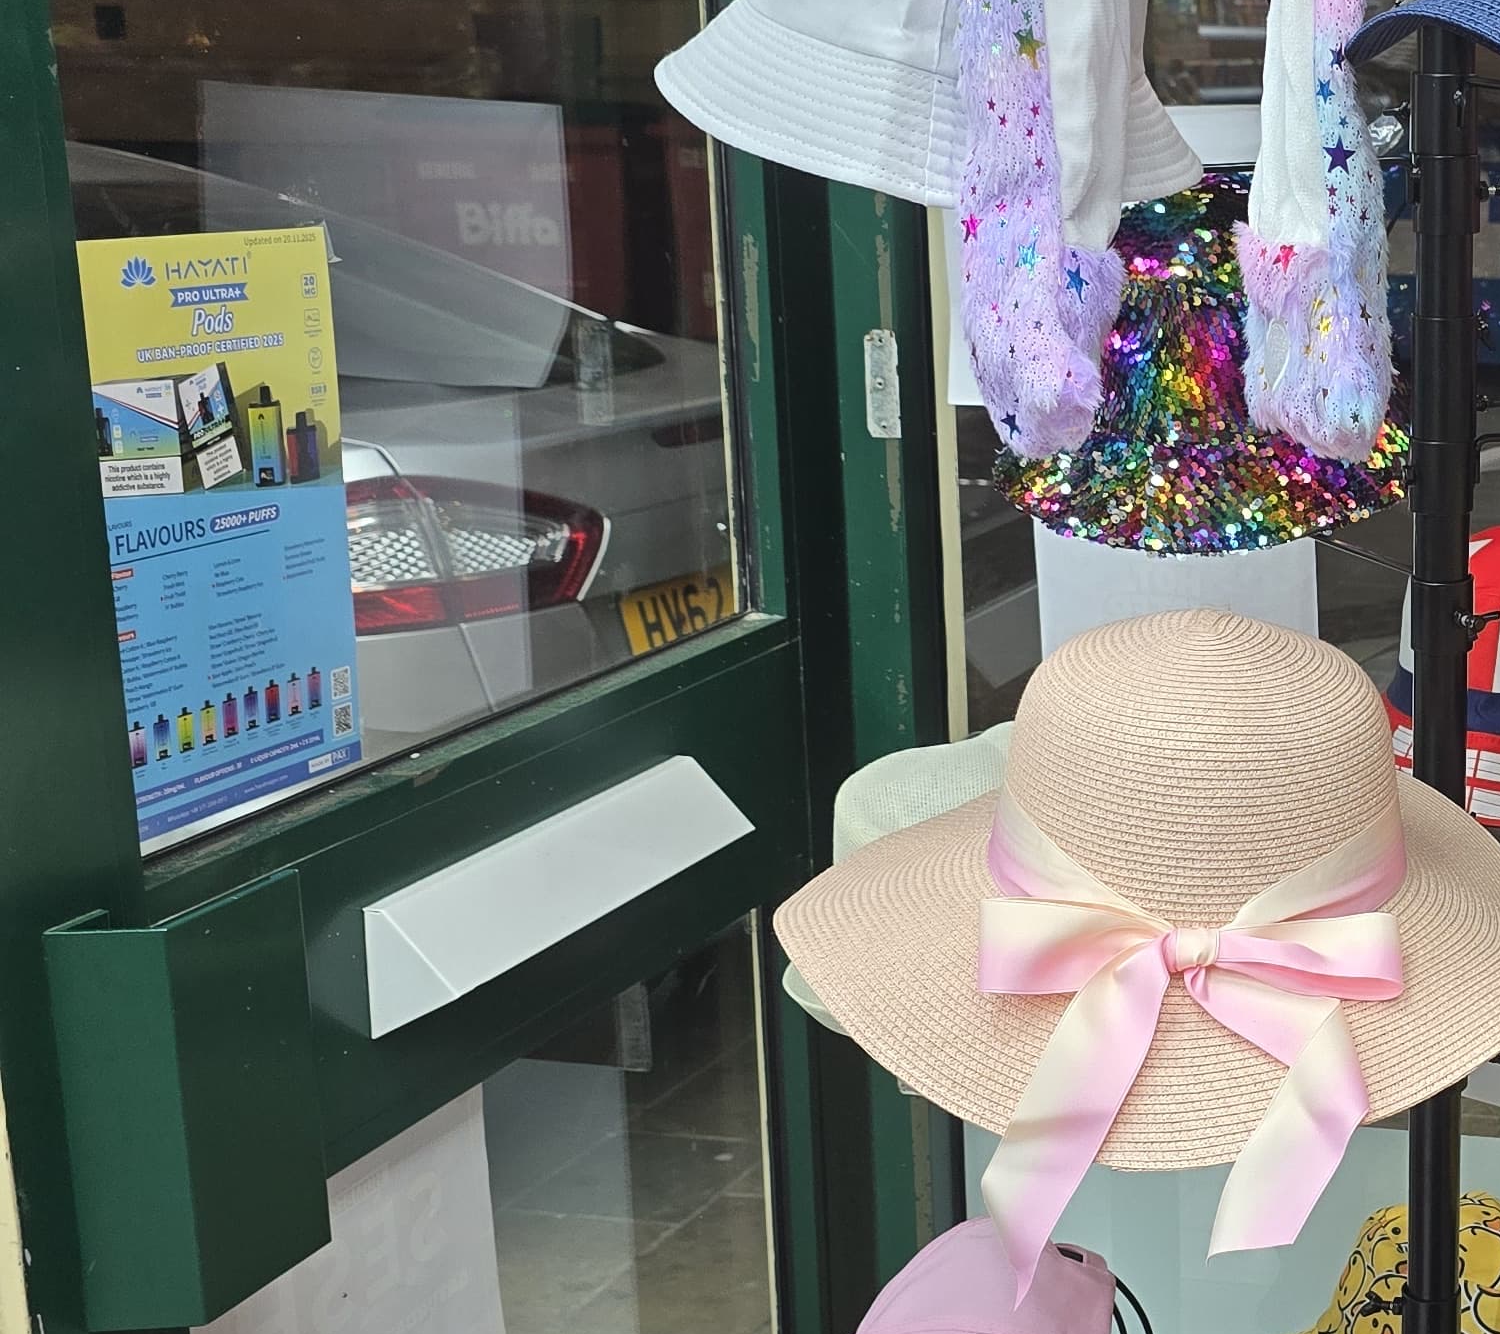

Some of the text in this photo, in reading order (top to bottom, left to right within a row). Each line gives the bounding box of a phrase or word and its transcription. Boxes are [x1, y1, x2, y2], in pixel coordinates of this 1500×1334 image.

[243, 235, 272, 247] Updated
[273, 236, 282, 244] on
[166, 256, 247, 281] HAYATI
[304, 276, 315, 286] 20
[177, 285, 242, 304] PRO ULTRA+
[192, 305, 234, 336] Pods
[137, 349, 154, 363] UK
[155, 343, 213, 361] BAN-PROOF
[214, 336, 261, 353] CERTIFIED
[262, 333, 284, 348] 2025
[105, 474, 126, 482] nicotine
[127, 473, 142, 481] which
[154, 472, 171, 481] highly
[108, 463, 165, 474] This product contains
[112, 483, 135, 491] addictive
[213, 506, 277, 531] 25000+ PUFFS
[115, 518, 206, 556] FLAVOURS
